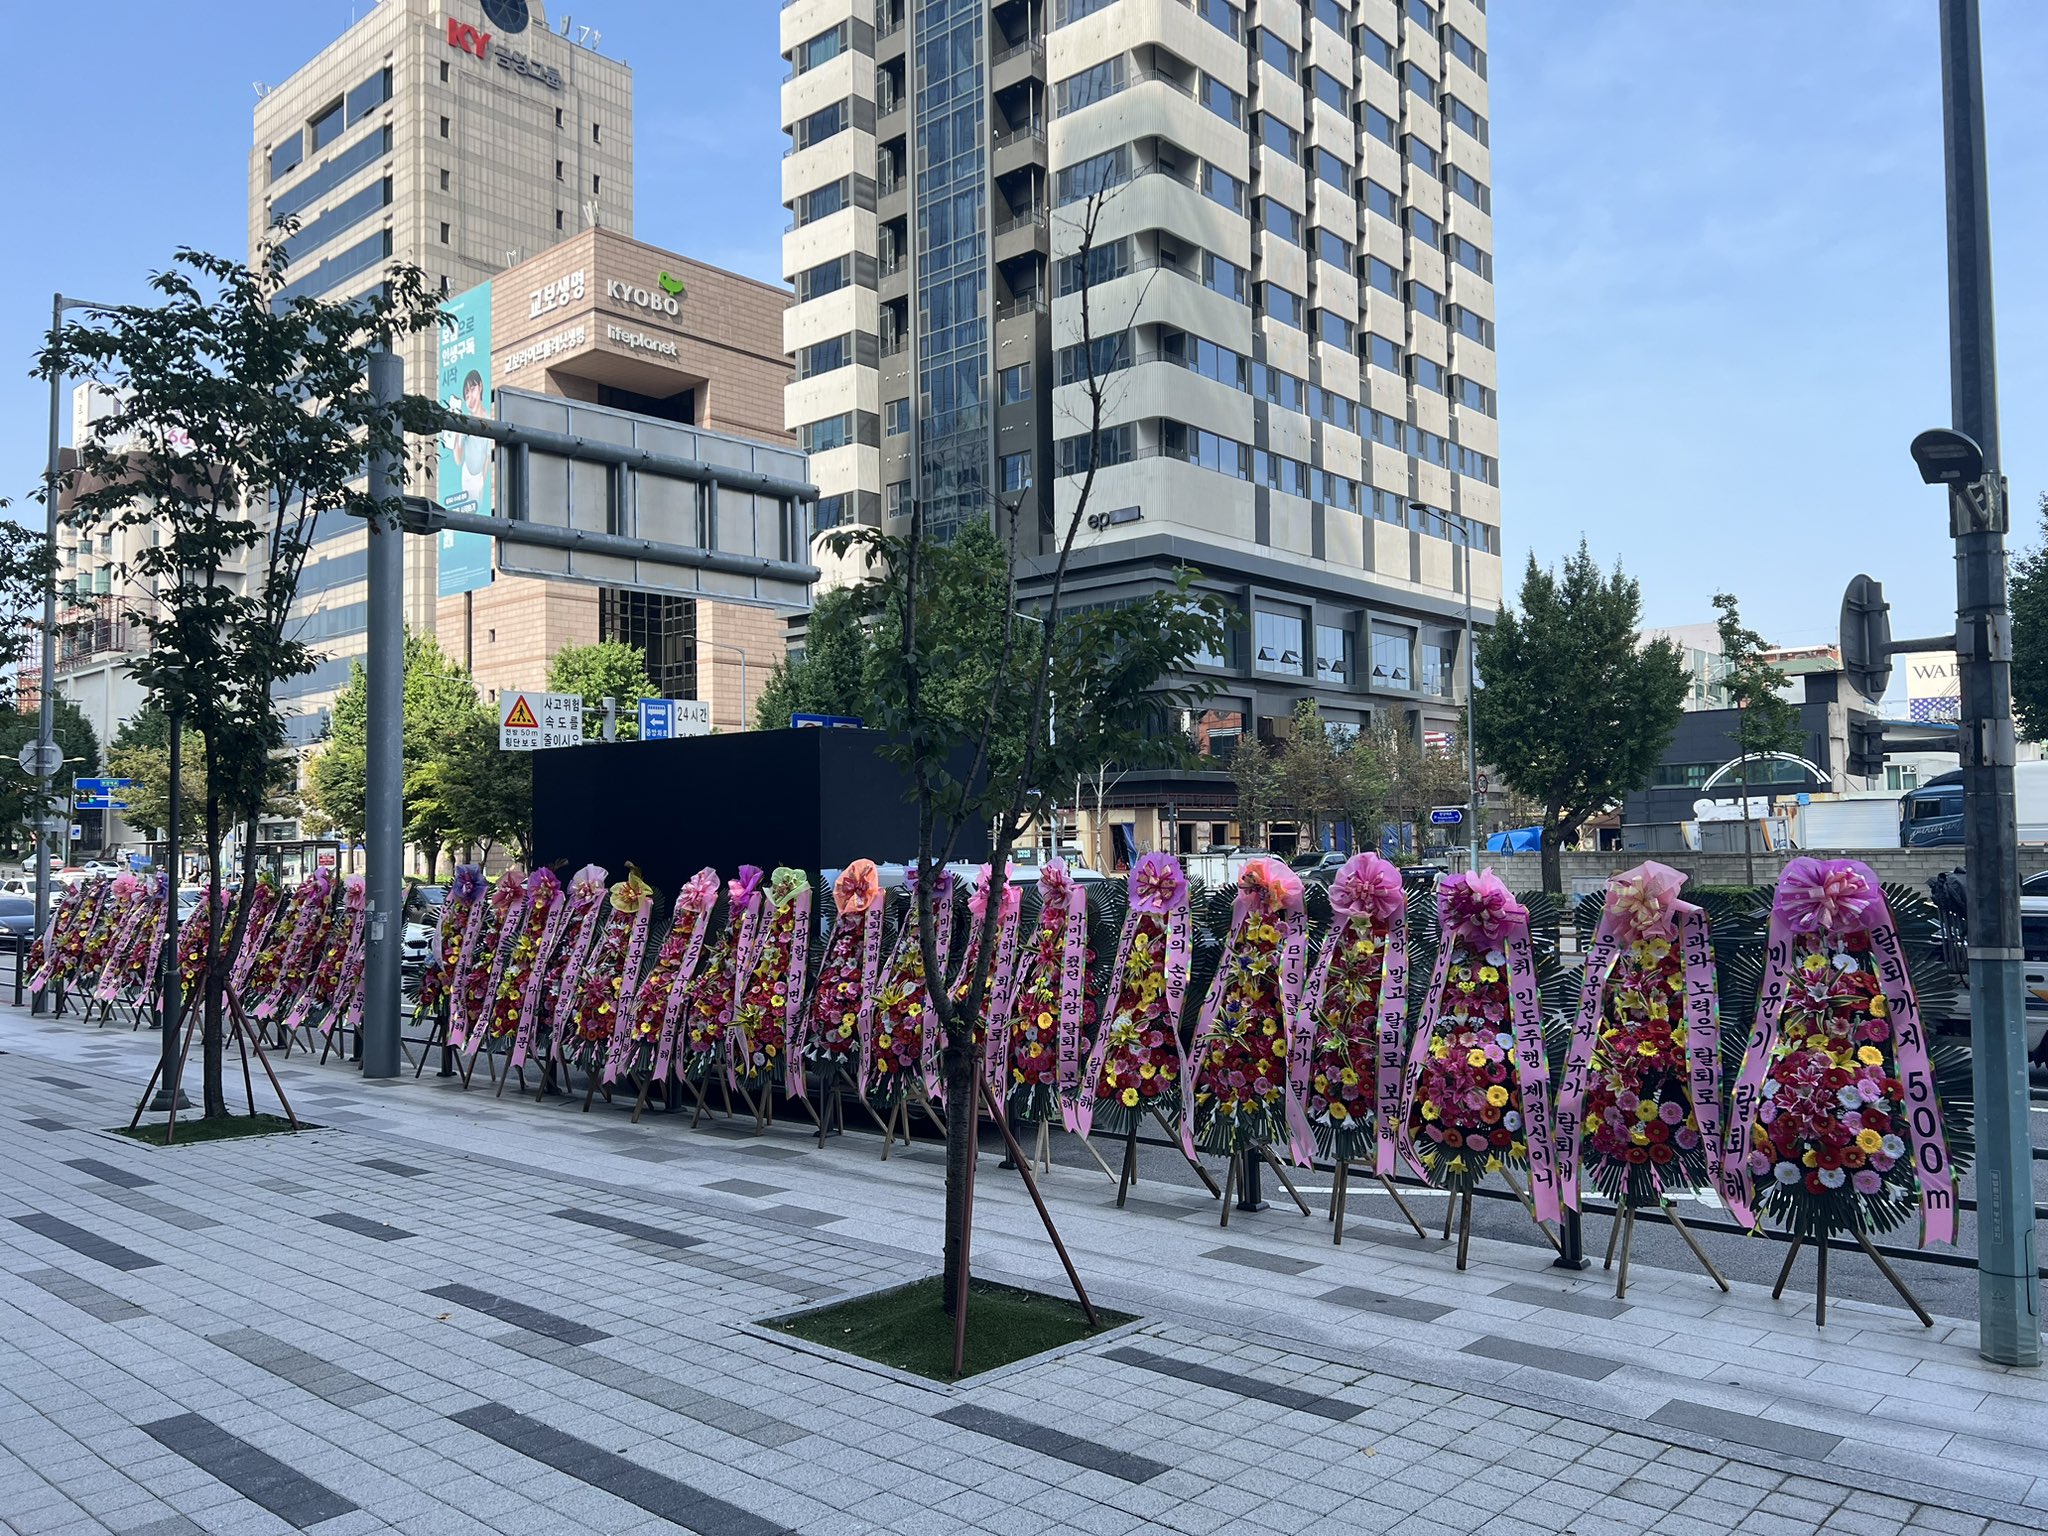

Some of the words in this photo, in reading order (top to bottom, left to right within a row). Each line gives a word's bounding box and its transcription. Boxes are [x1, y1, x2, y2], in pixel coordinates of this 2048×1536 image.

[448, 17, 491, 60] KY
[529, 269, 585, 320] 교보생명
[607, 279, 679, 315] KYOBO
[607, 324, 677, 356] lifeplanet
[442, 366, 458, 386] 시작
[544, 697, 580, 712] 사고위험
[544, 715, 579, 730] 속도를
[505, 738, 538, 747] 횡단보도
[543, 733, 579, 747] 줄이시오
[1000, 912, 1017, 966] 비겁하게
[1068, 912, 1085, 948] 아미가
[1171, 906, 1188, 954] 우리의
[1289, 911, 1306, 937] 슈가
[1391, 918, 1407, 955] 음악
[1684, 913, 1714, 969] 사과와
[1286, 945, 1301, 984] BTS
[1511, 938, 1531, 977] 만취
[1063, 988, 1080, 1015] 사랑
[1385, 966, 1407, 999] 말고
[1574, 934, 1616, 1041] 음주운전자
[1751, 940, 1787, 1059] 민윤기
[1516, 988, 1541, 1068] 인도주행
[1688, 980, 1716, 1035] 노력은
[924, 1027, 936, 1075] 하지마
[1060, 1022, 1079, 1062] 탈퇴로
[1295, 1027, 1312, 1067] 슈가
[1381, 1012, 1404, 1069] 탈퇴로
[1080, 1057, 1101, 1112] 탈퇴해
[1563, 1055, 1587, 1098] 슈가
[1693, 1047, 1720, 1106] 탈퇴로
[1872, 925, 1922, 1054] 탈퇴까지
[1908, 1071, 1950, 1209] 500m
[1522, 1079, 1553, 1188] 제정신이니
[1556, 1111, 1580, 1182] 탈퇴해
[1724, 1083, 1757, 1209] 탈퇴해
